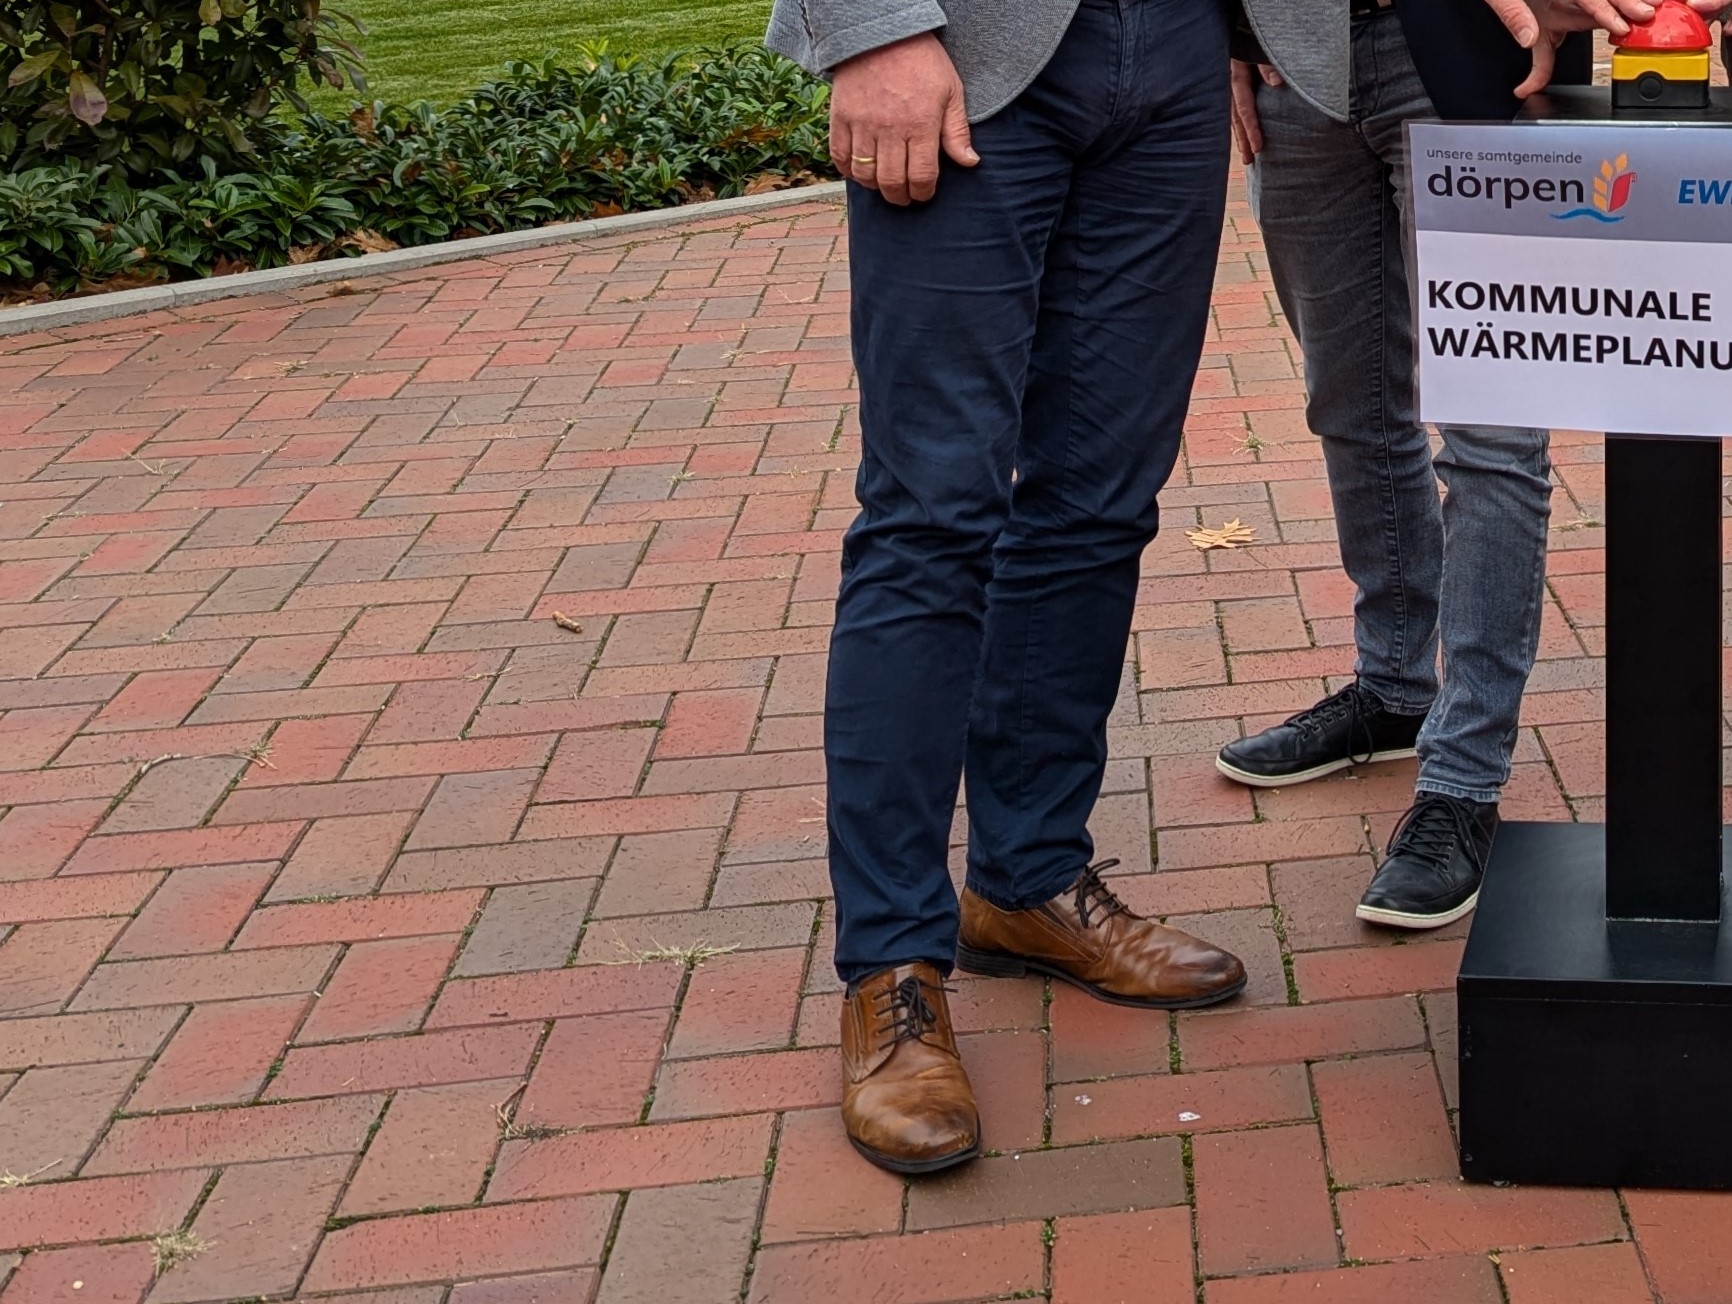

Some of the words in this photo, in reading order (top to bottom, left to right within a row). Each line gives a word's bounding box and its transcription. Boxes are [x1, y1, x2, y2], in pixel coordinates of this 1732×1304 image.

[1426, 148, 1473, 161] unsere
[1477, 151, 1583, 166] samtgemeinde
[1427, 165, 1585, 209] dörpen
[1427, 280, 1712, 322] KOMMUNALE
